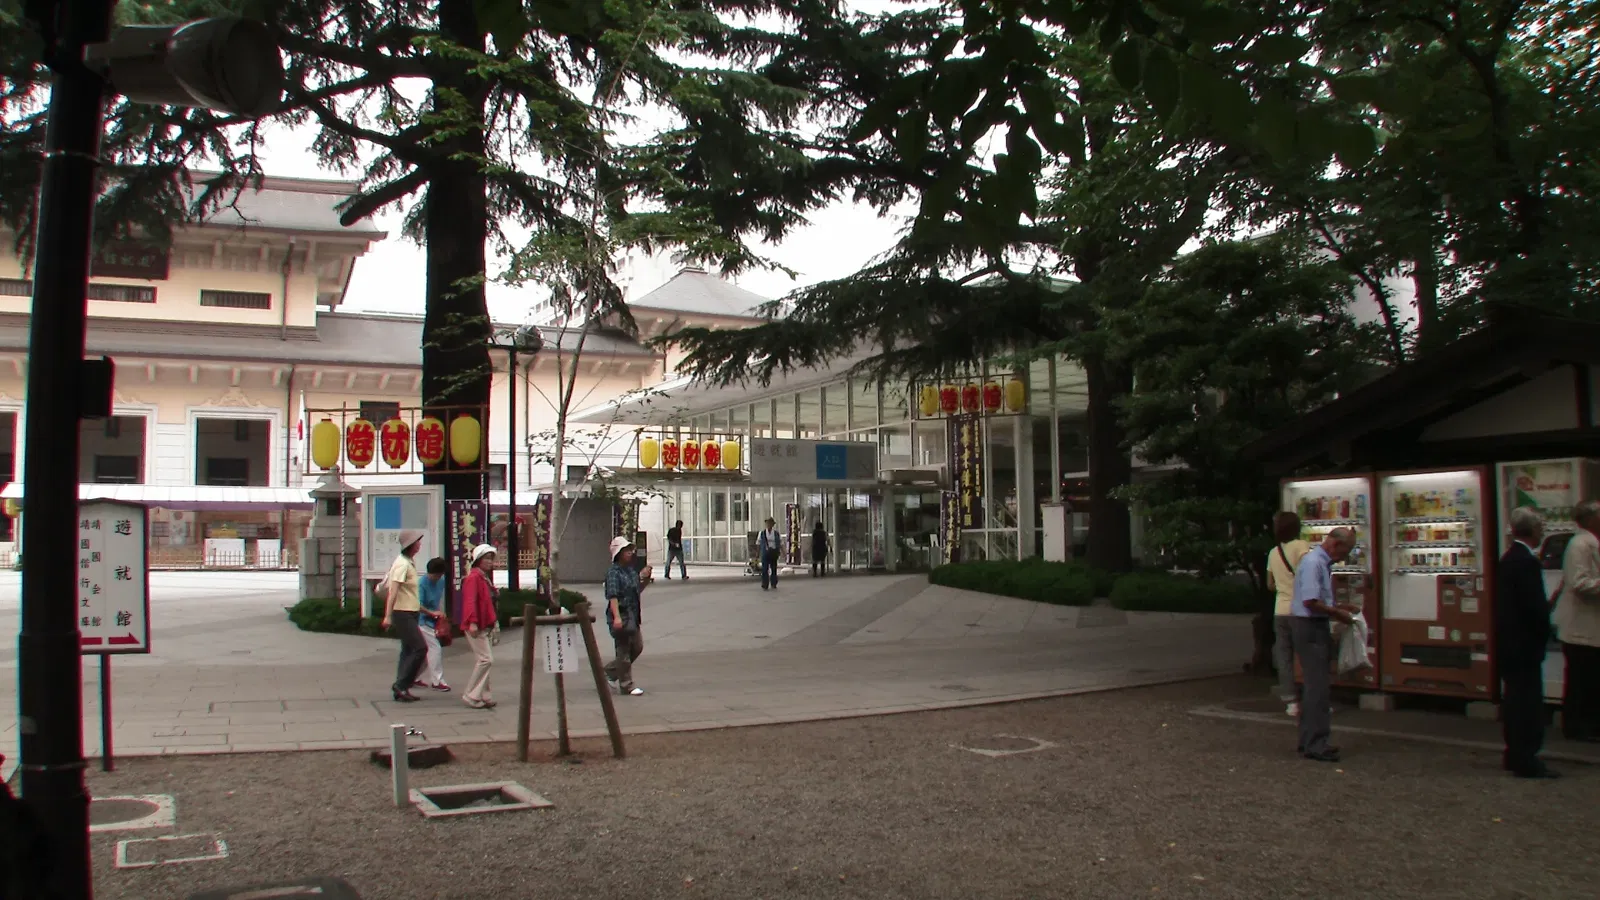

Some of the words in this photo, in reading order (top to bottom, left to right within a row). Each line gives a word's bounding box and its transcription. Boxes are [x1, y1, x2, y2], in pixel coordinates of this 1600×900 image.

[346, 423, 445, 464] 遊就館
[662, 442, 721, 467] 遊就館
[91, 519, 102, 627] 靖國会館
[114, 519, 133, 627] 遊就館
